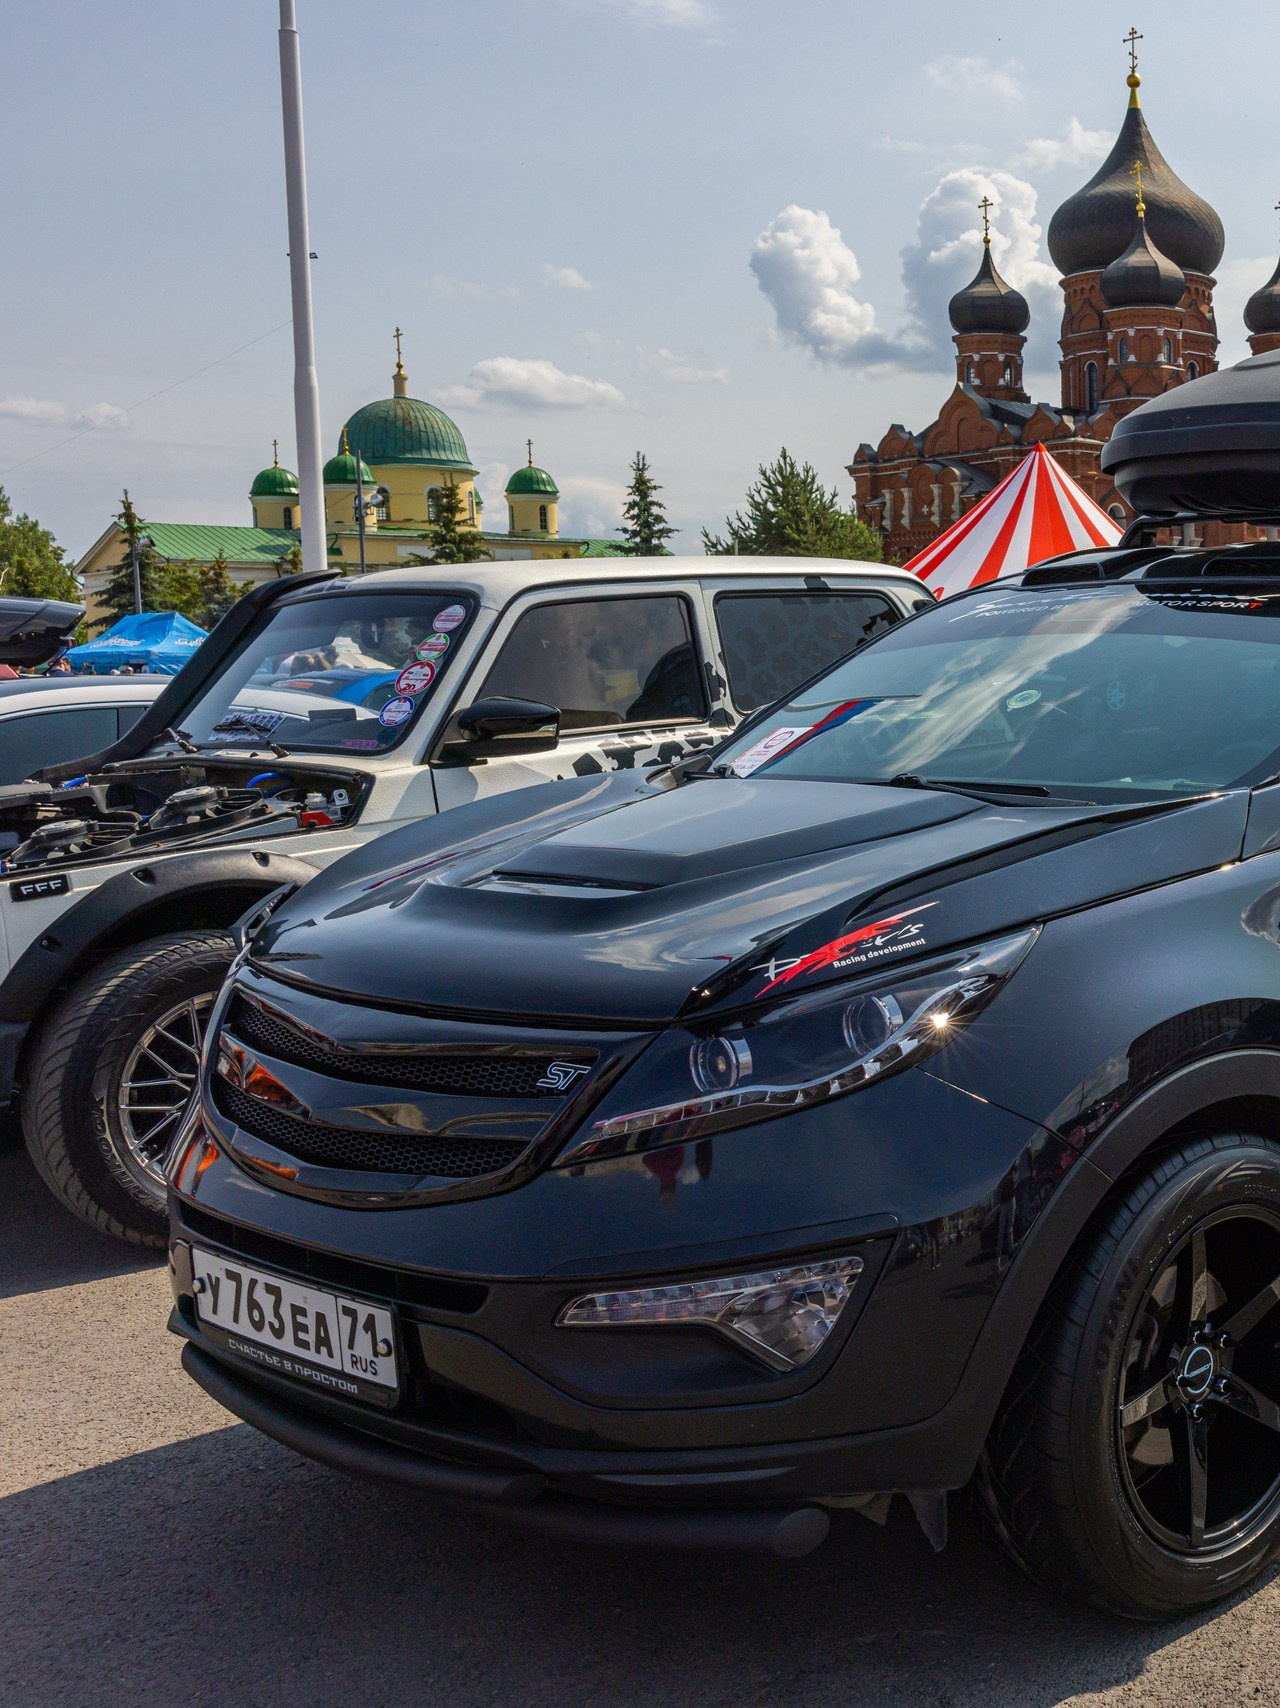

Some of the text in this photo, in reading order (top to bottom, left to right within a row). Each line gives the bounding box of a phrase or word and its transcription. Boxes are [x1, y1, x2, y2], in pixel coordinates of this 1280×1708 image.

[975, 605, 1048, 618] POWERED
[20, 879, 62, 895] FFF
[832, 937, 927, 969] Racing development
[537, 1061, 592, 1090] ST
[228, 1339, 358, 1394] СЧАСТЬЕ В ПРОСТОМ
[351, 1353, 378, 1376] RUS
